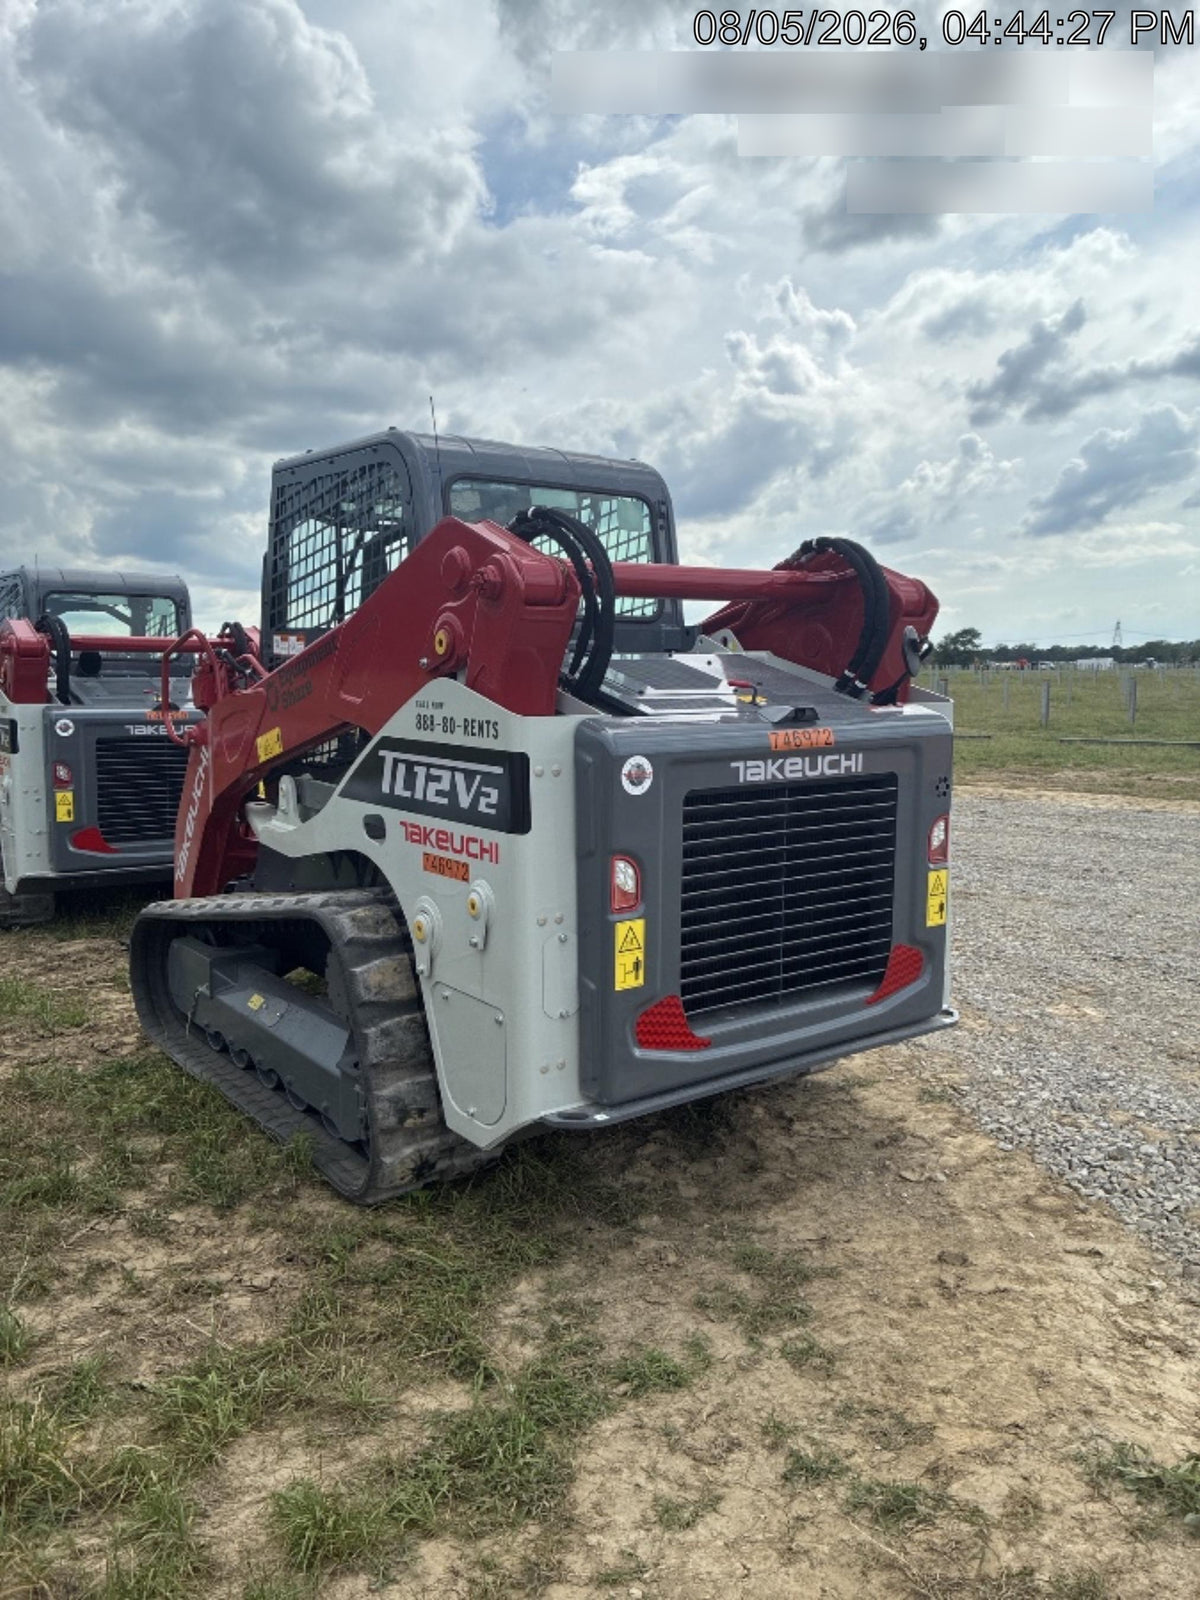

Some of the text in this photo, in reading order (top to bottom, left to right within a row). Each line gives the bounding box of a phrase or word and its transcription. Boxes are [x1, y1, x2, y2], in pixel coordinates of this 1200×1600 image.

[770, 729, 833, 750] 746972
[731, 753, 863, 783] TAKEUCHI
[399, 820, 499, 864] TAKEUCHI
